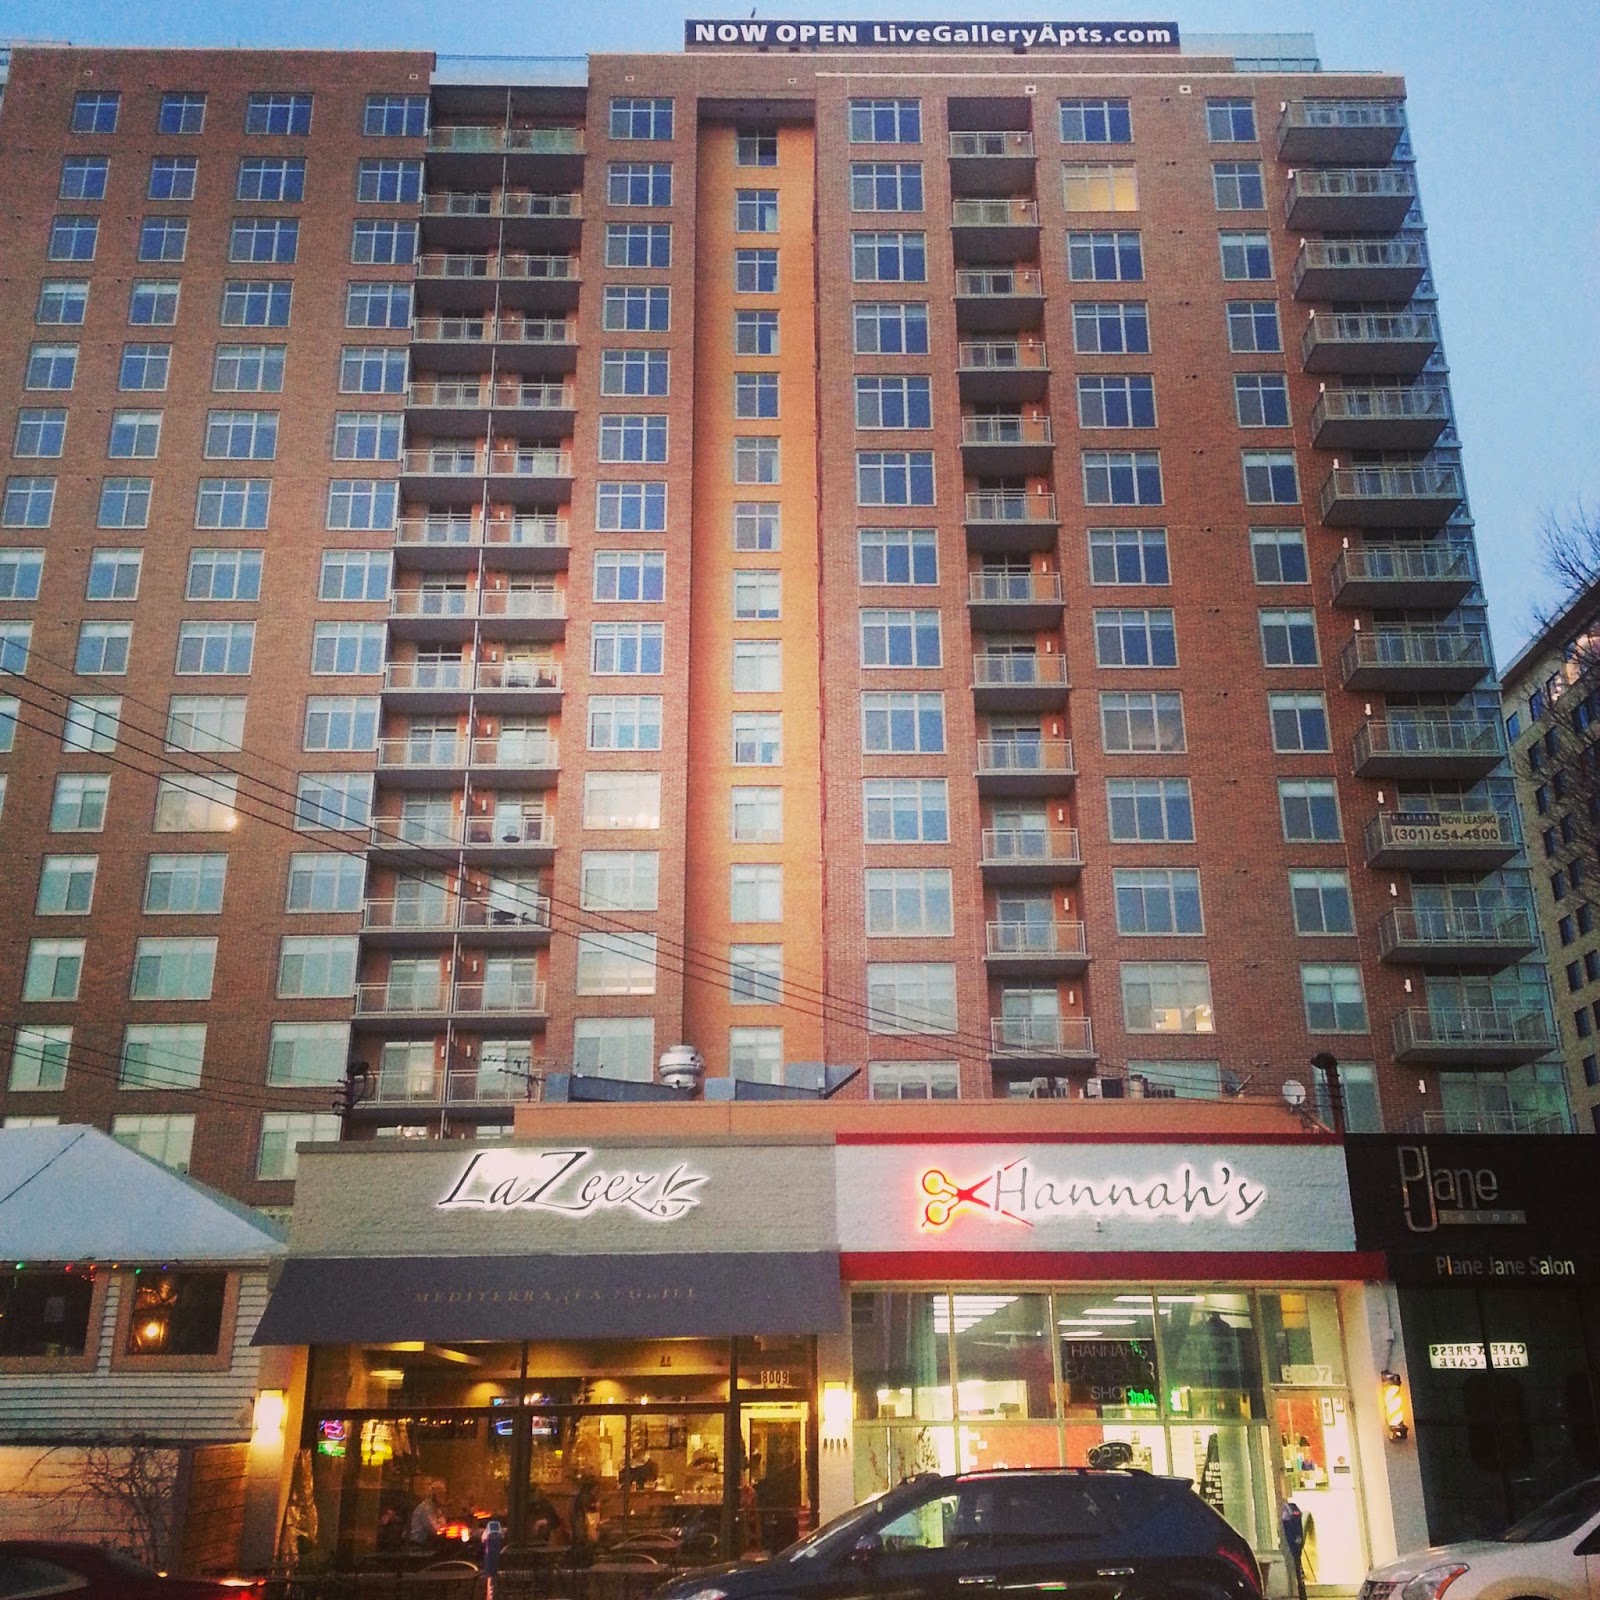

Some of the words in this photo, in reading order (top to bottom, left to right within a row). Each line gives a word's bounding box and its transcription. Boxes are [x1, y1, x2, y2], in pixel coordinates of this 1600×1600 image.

[694, 24, 767, 43] NOW
[775, 24, 858, 43] OPEN
[873, 24, 1171, 47] LiveGalleryApts.com
[1441, 816, 1461, 825] NOW
[1463, 815, 1497, 824] LEASING
[1395, 828, 1431, 841] (301)
[994, 1166, 1264, 1217] Hannah's
[1436, 1255, 1483, 1276] Plane
[1488, 1255, 1526, 1276] Jane
[1530, 1255, 1576, 1277] Salon
[761, 1371, 789, 1384] 8009
